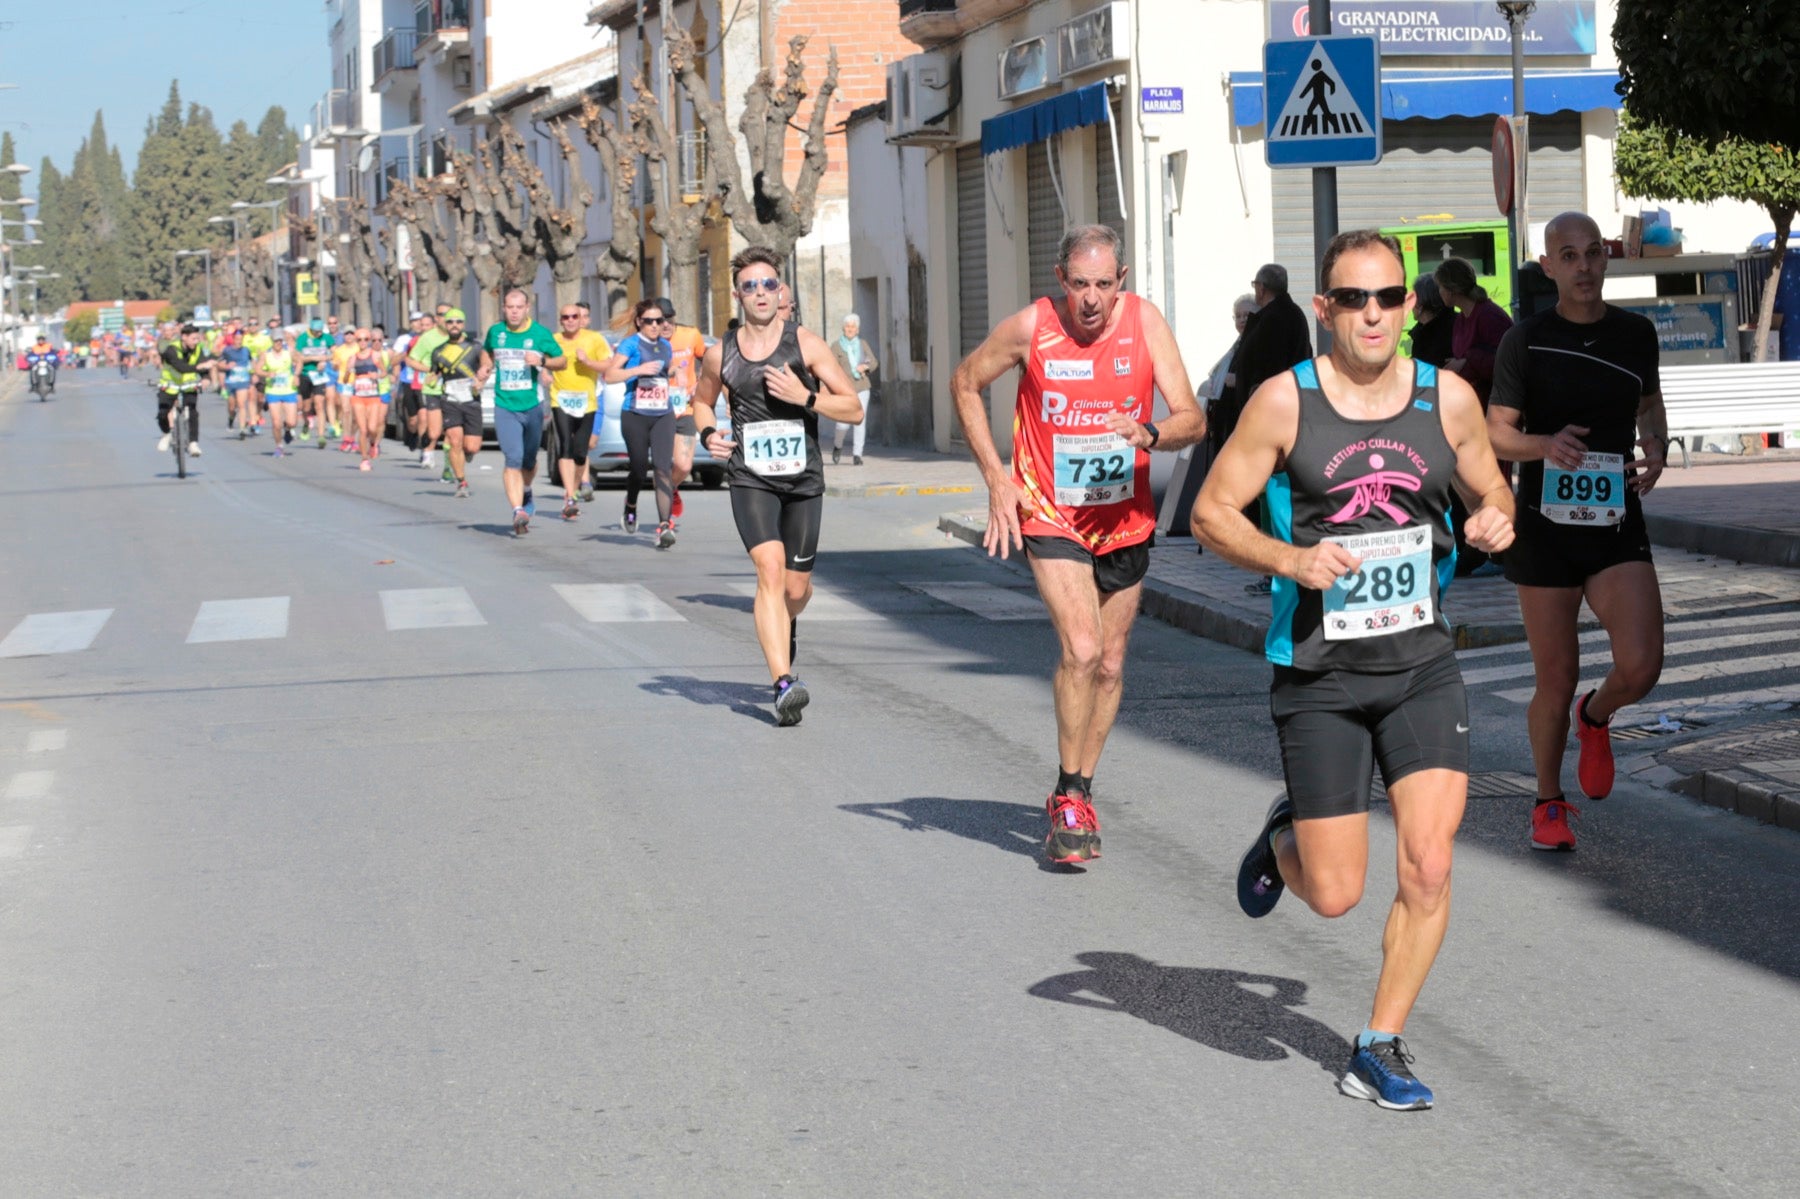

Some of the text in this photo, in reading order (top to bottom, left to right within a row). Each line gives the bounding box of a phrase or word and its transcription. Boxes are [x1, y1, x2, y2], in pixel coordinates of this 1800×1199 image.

[1338, 11, 1440, 26] GRANADINA
[1150, 88, 1173, 97] PLAZA
[1143, 99, 1182, 111] NARANJOS
[1658, 332, 1708, 344] portante
[504, 370, 526, 380] 792
[639, 387, 667, 399] 2261
[1072, 399, 1115, 410] Clínicas
[750, 436, 802, 458] 1137
[1323, 438, 1429, 480] ATLETISMO CULLAR VEGA
[1068, 454, 1125, 484] 732
[1557, 473, 1612, 503] 899
[1350, 539, 1370, 548] GRAN
[1370, 535, 1396, 546] PREMIO
[1397, 534, 1406, 543] DE
[1343, 561, 1415, 605] 289
